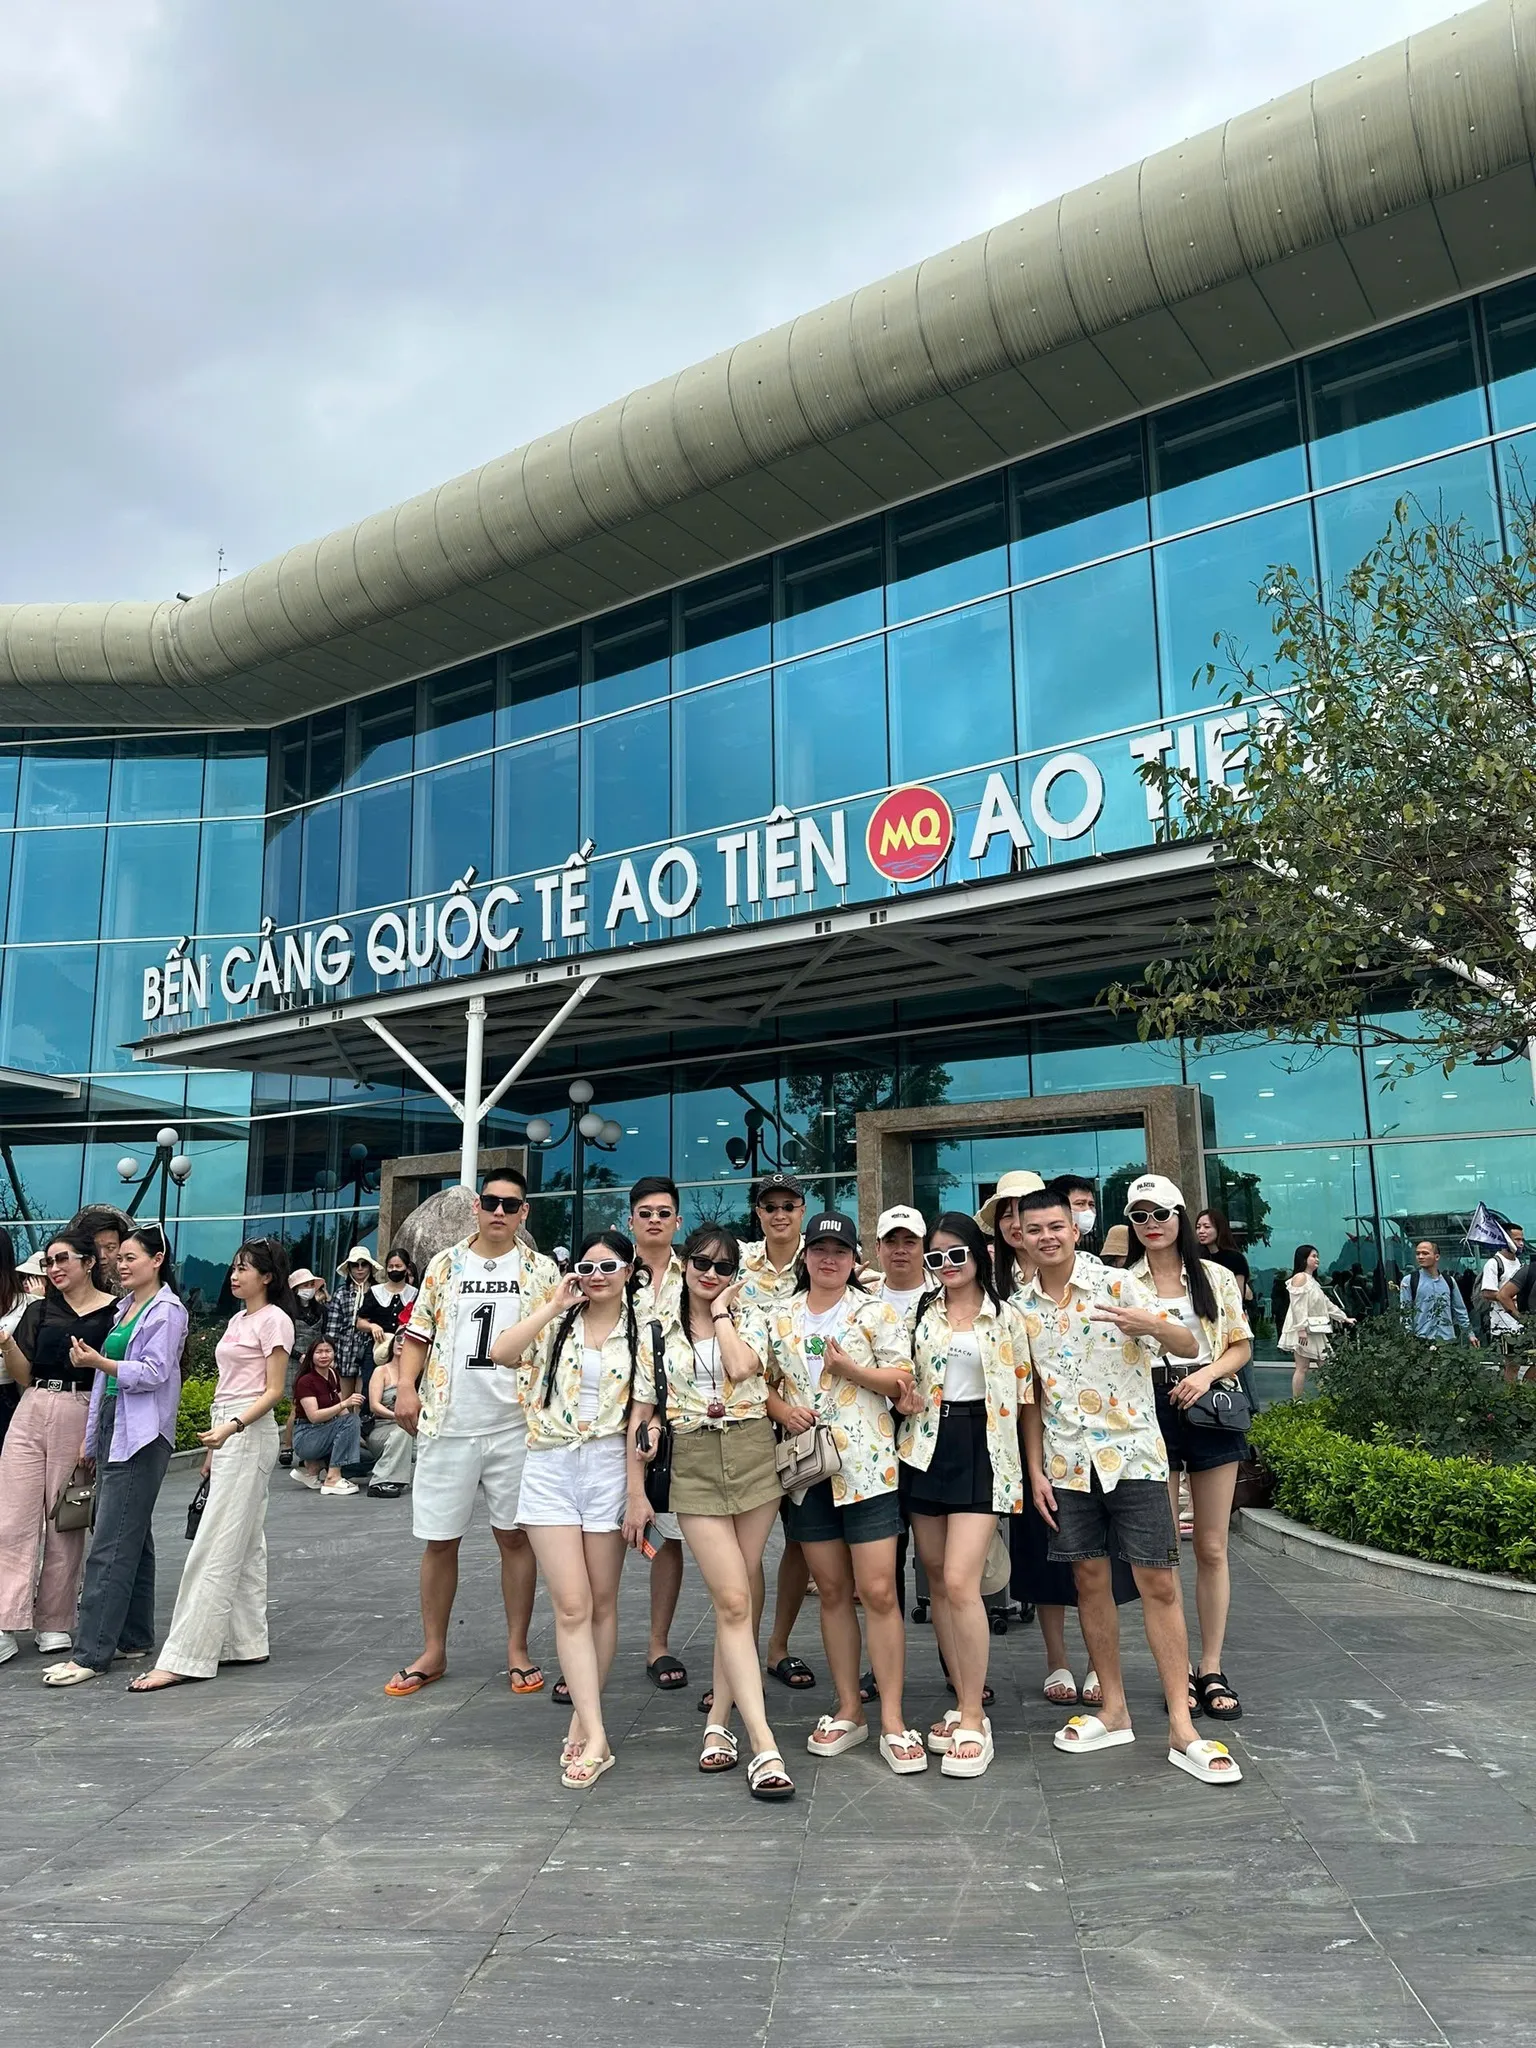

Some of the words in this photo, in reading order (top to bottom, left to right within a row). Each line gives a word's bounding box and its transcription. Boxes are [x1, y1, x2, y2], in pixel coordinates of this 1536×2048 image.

[879, 808, 941, 856] MQ
[968, 752, 1104, 860] AO
[142, 936, 210, 1021] BẾN
[220, 916, 353, 1004] CẢNG
[367, 865, 523, 975] QUỐC
[534, 837, 597, 942] TẾ
[604, 846, 700, 930] AO
[717, 804, 848, 907] TIÊN
[819, 1220, 842, 1231] MIU
[459, 1281, 520, 1294] KLEBA
[465, 1302, 496, 1369] 1
